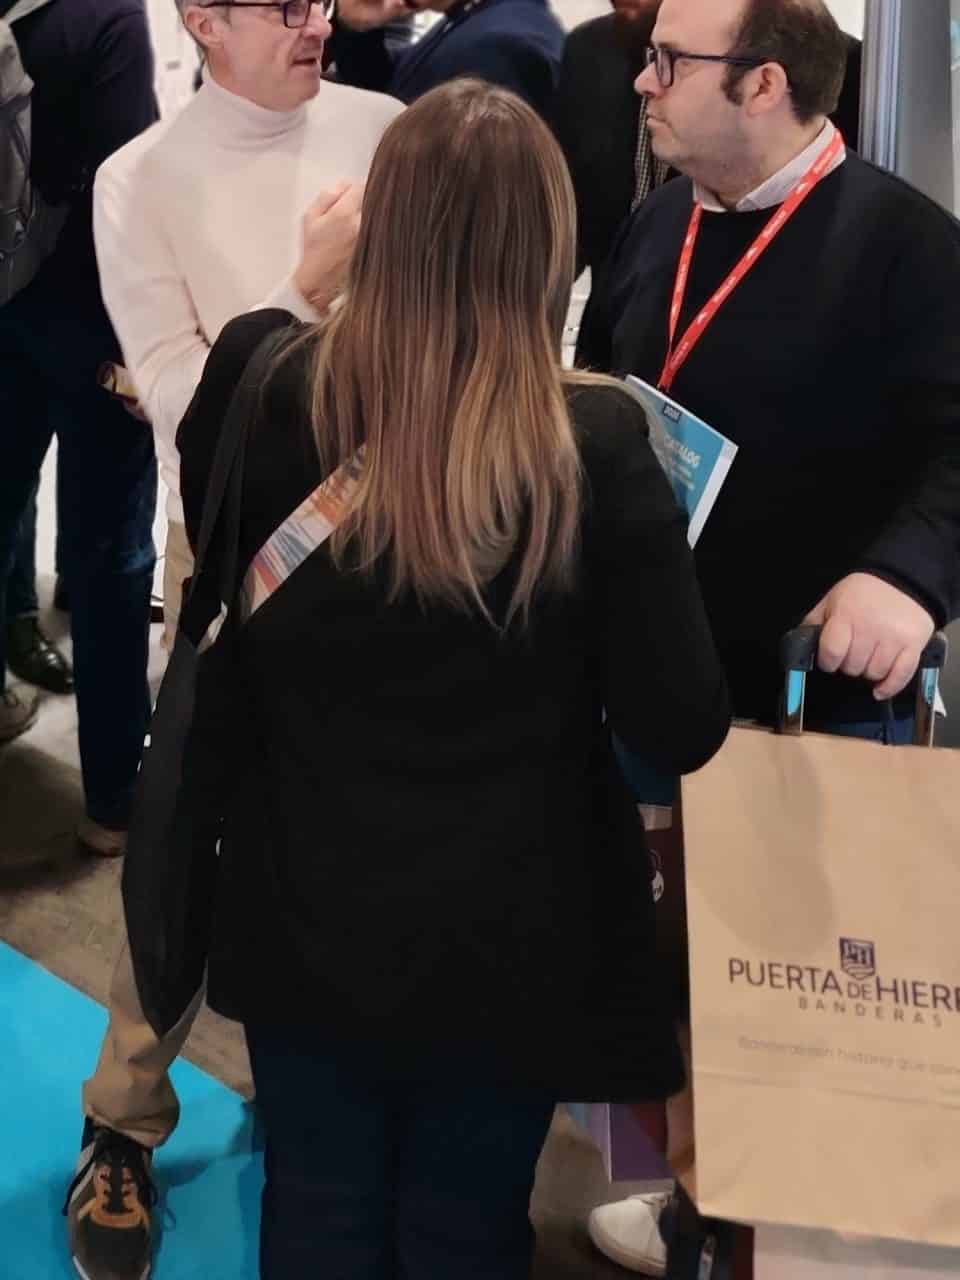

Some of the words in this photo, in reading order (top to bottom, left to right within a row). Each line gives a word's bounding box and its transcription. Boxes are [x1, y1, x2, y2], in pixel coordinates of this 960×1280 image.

[728, 958, 843, 996] PUERTA
[847, 982, 872, 1001] DE
[876, 975, 960, 1013] HIER
[798, 996, 943, 1029] BANDERAS
